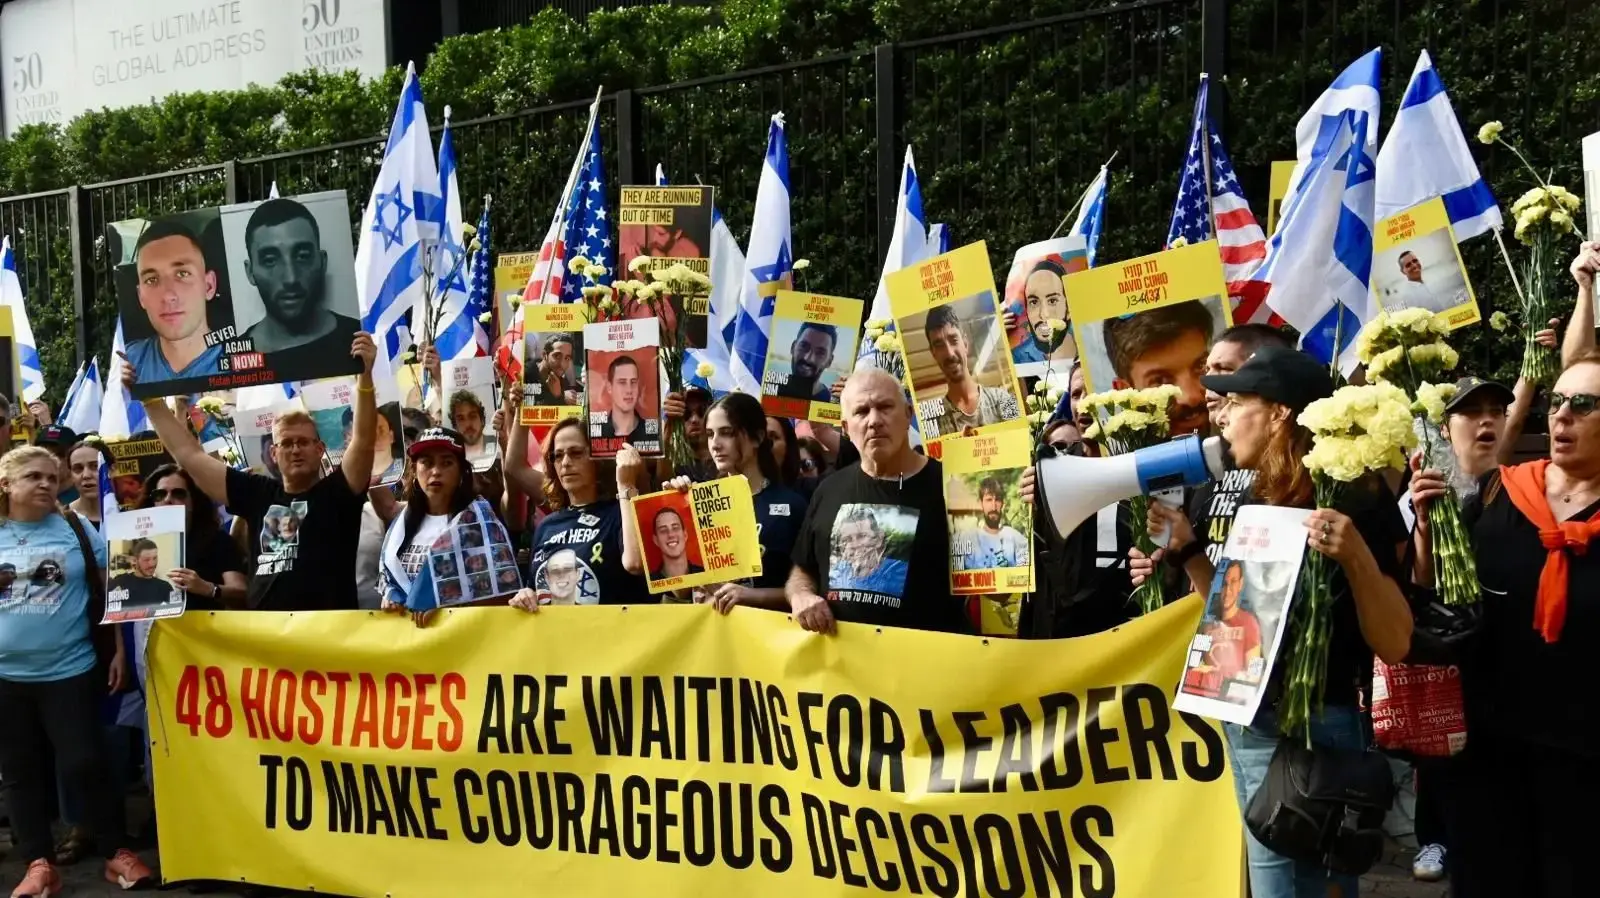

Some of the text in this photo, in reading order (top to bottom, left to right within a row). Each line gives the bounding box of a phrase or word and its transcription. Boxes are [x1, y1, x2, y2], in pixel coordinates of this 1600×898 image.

[110, 1, 243, 50] THE ULTIMATE
[302, 0, 341, 33] 50
[304, 26, 360, 52] UNITED
[93, 29, 267, 88] GLOBAL ADDRESS
[304, 46, 363, 68] NATIONS
[13, 51, 43, 95] 50
[623, 190, 700, 204] THEY ARE RUNNING
[622, 209, 673, 223] OUT OF TIME
[500, 256, 518, 267] THEY
[1118, 271, 1168, 294] DAVID CUNIO
[205, 325, 236, 347] NEVER
[225, 339, 252, 354] AGAIN
[220, 353, 264, 371] IS NOW!
[765, 370, 789, 385] BRING
[763, 383, 779, 396] HIM
[590, 411, 608, 424] BRING
[920, 398, 945, 419] BRING
[922, 418, 940, 440] HIM
[124, 441, 161, 455] RUNNING
[118, 461, 137, 473] TIME
[692, 483, 720, 502] DON'T
[695, 496, 731, 516] FORGET
[698, 514, 714, 530] ME
[568, 528, 600, 544] HERO
[701, 525, 732, 543] BRING
[704, 541, 720, 557] ME
[707, 552, 739, 570] HOME.
[952, 572, 972, 588] HOME
[973, 570, 996, 588] NOW!
[1393, 671, 1445, 686] money
[177, 665, 1225, 793] 48 HOSTAGES ARE WAITING FOR LEADERS
[260, 755, 1115, 898] TO MAKE COURAGEOUS DECISIONS
